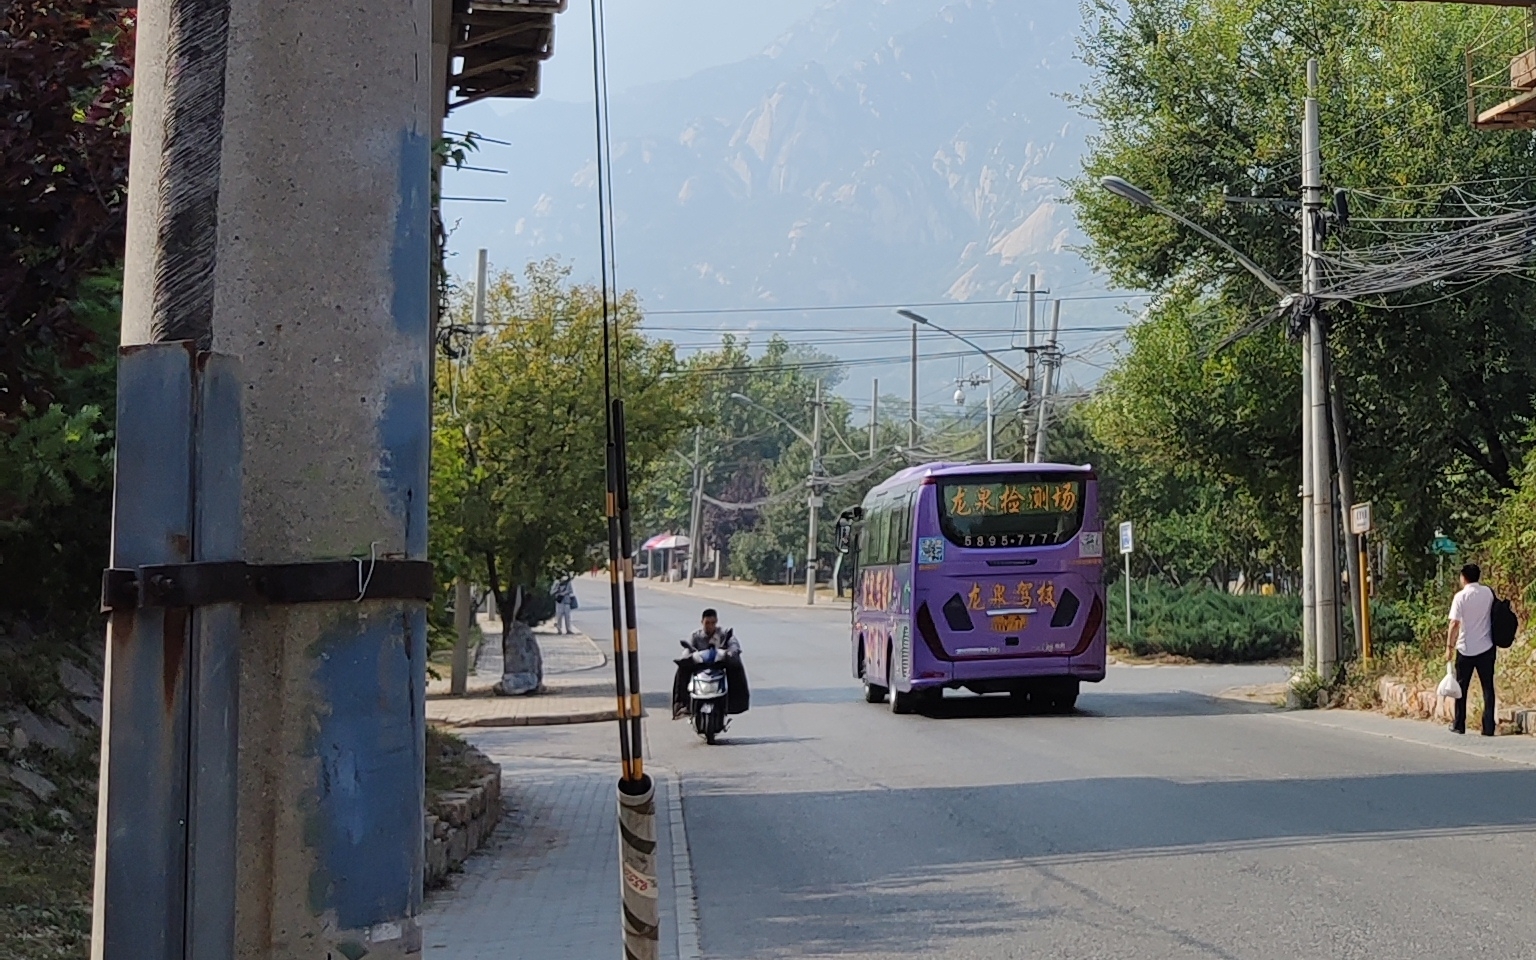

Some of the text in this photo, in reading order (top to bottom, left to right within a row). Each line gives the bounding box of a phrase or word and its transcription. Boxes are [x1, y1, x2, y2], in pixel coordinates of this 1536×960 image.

[950, 481, 1077, 516] 龙泉检测场
[967, 580, 1057, 611] 龙泉驾校
